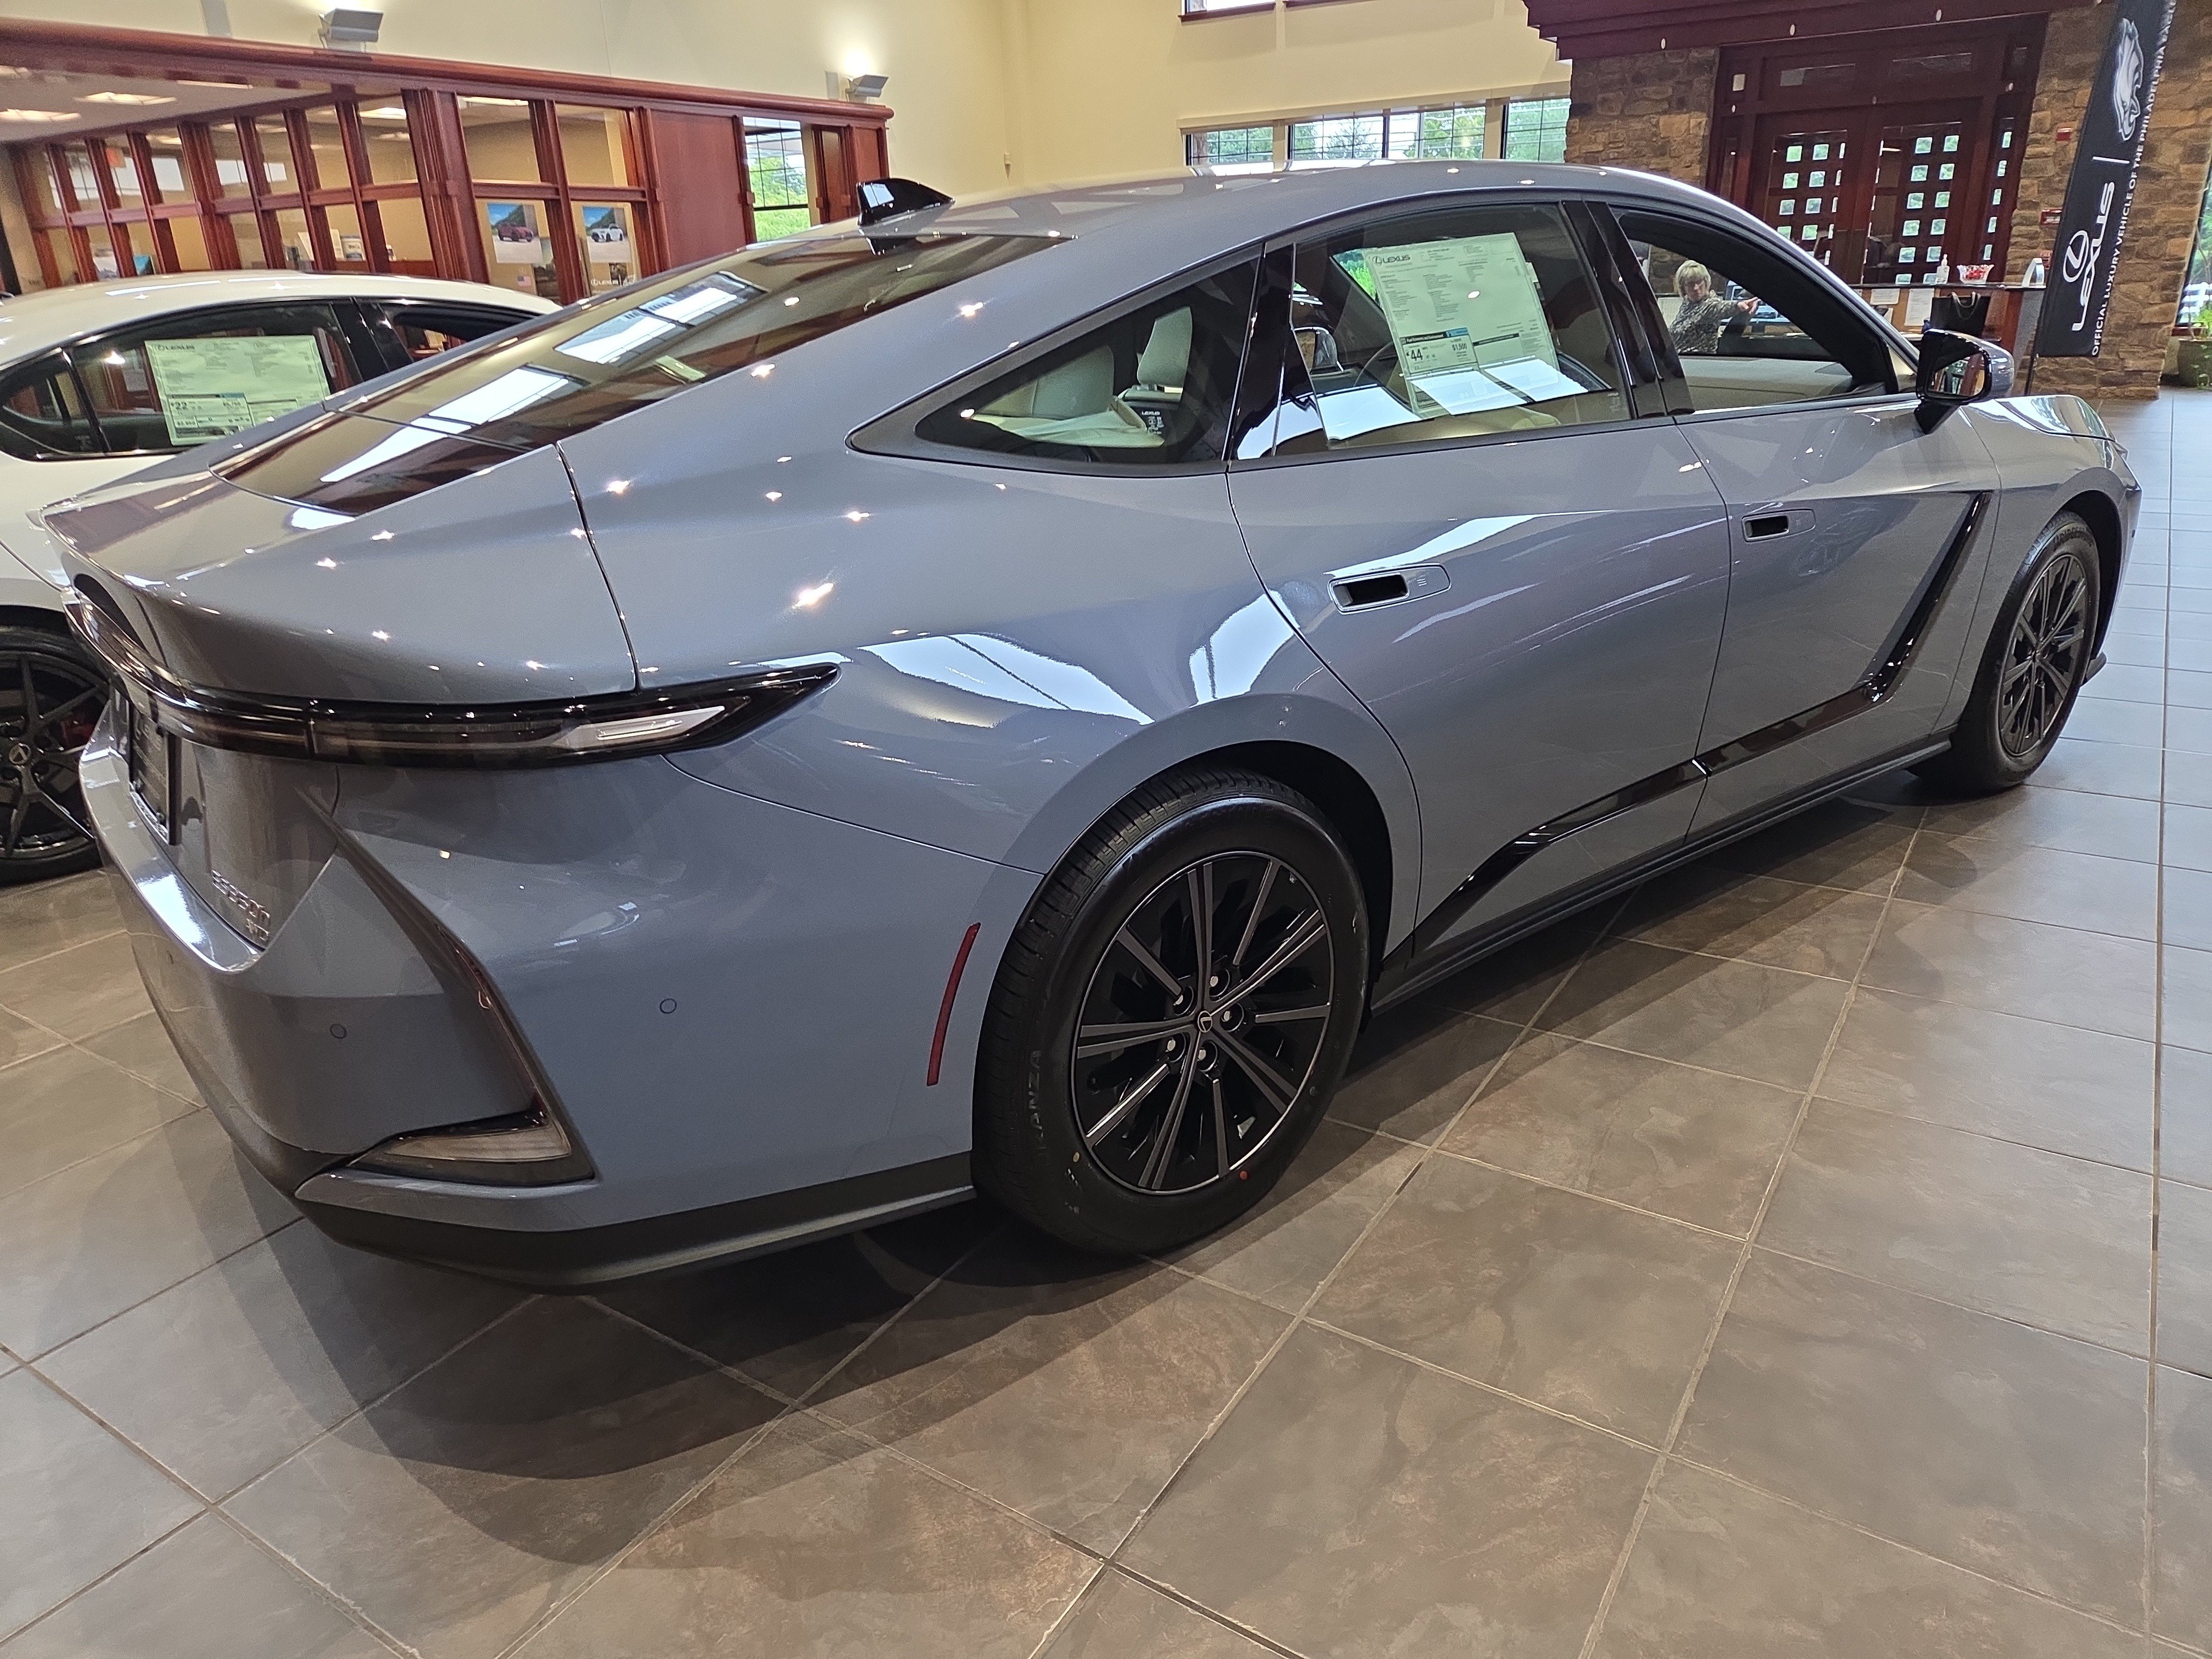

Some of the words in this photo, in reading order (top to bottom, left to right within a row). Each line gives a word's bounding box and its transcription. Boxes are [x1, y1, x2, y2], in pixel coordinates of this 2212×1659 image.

[2139, 46, 2166, 141] PHILADELPHIA
[2129, 172, 2138, 189] OF
[2133, 145, 2144, 168] THE
[2116, 192, 2133, 245] VEHICLE
[1383, 254, 1411, 263] LEXUS
[2072, 182, 2114, 331] LEXUS
[2104, 248, 2120, 298] LUXURY
[2092, 301, 2108, 356] OFFICIAL
[1411, 349, 1423, 361] 44
[1028, 1050, 1050, 1166] URANZA
